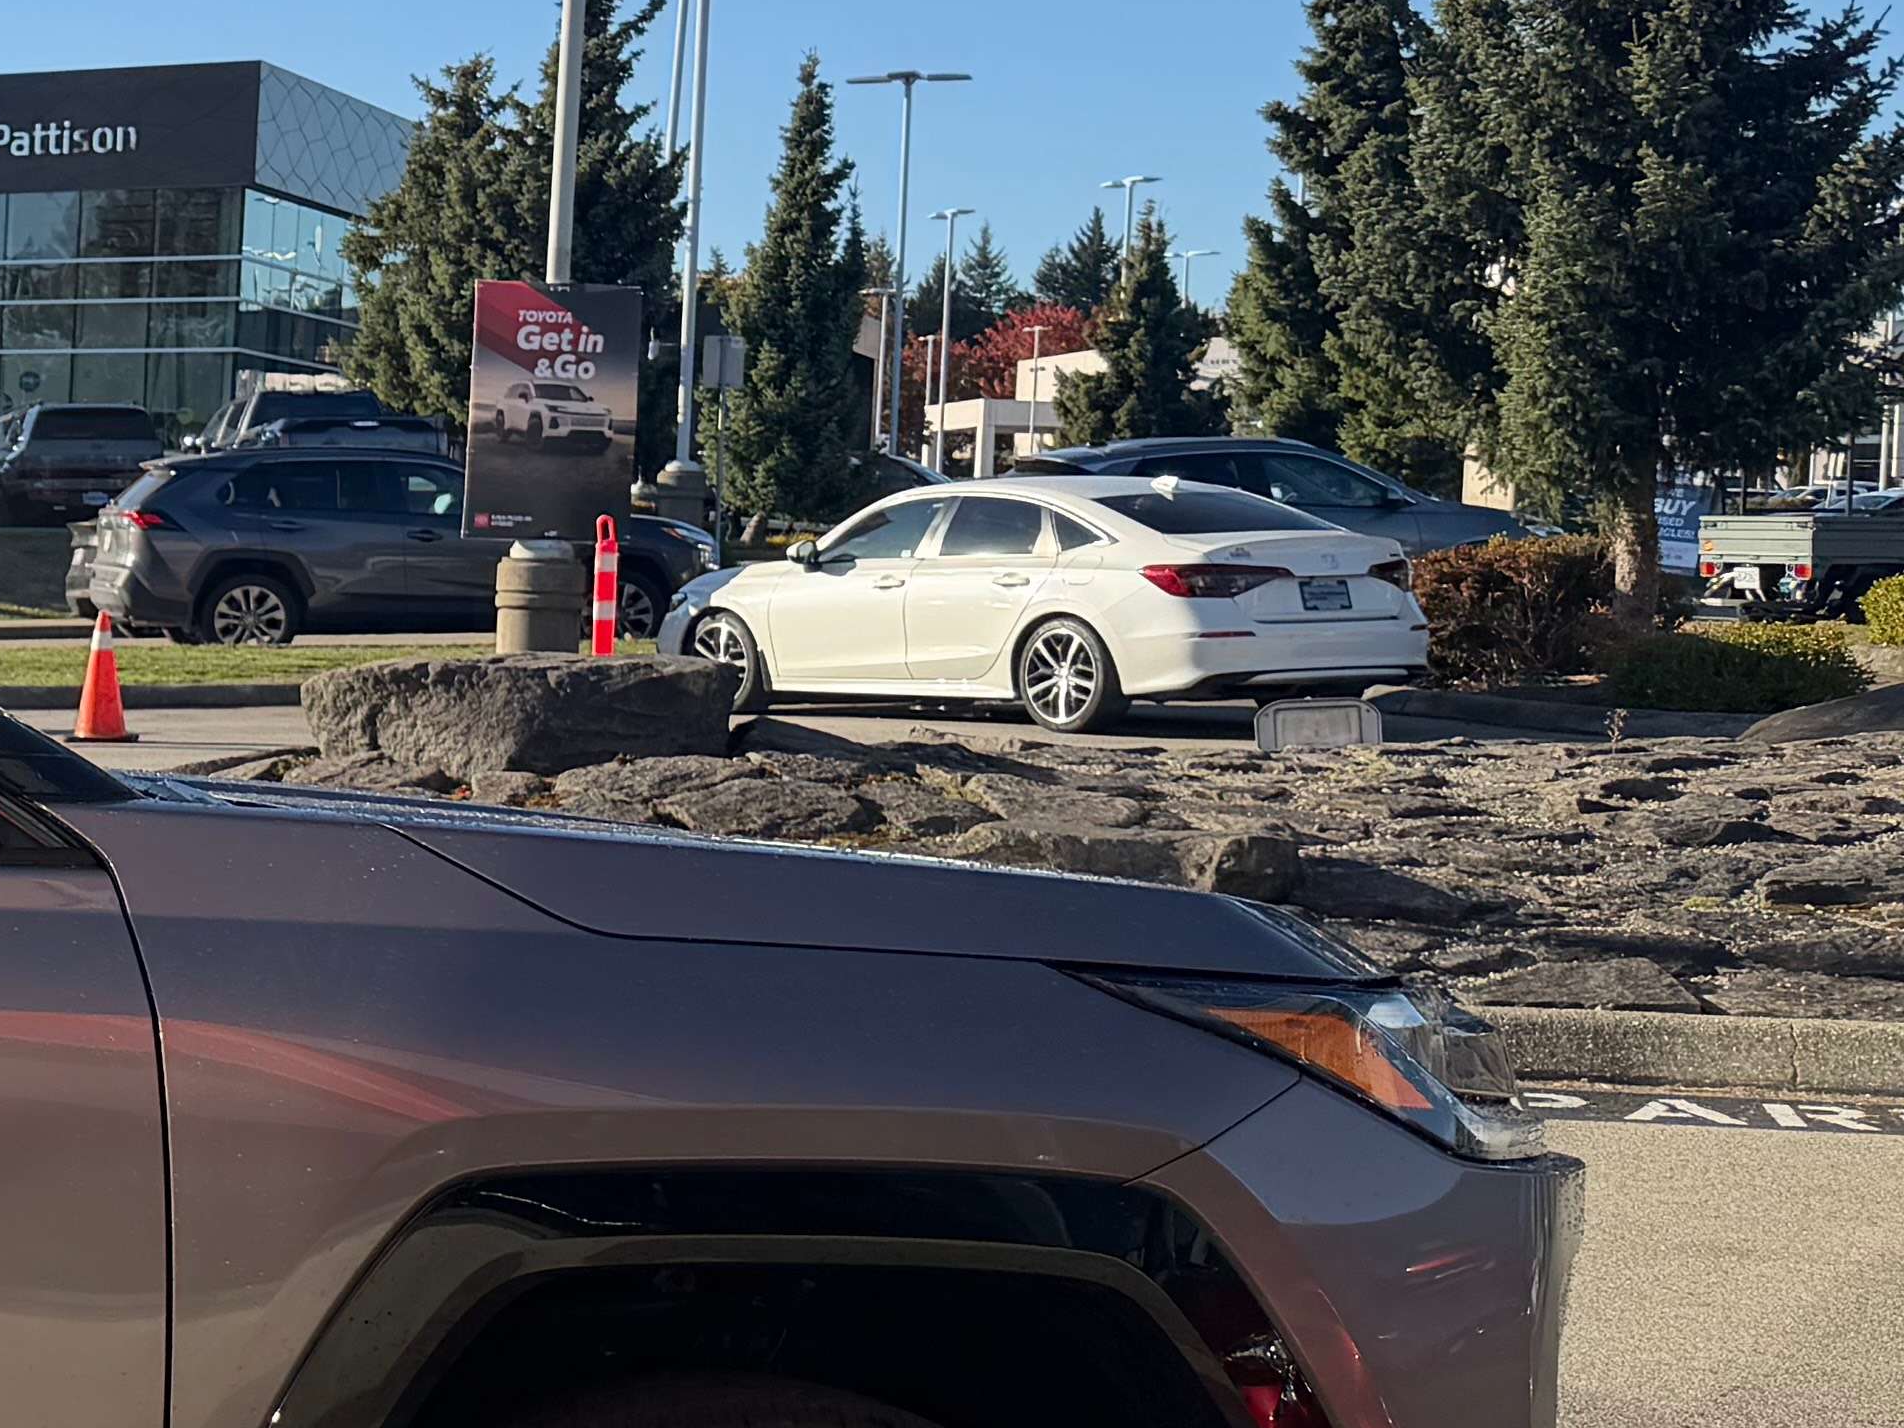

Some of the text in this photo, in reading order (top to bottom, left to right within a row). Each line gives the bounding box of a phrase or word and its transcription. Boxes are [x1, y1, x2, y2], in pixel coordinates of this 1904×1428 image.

[518, 309, 573, 324] TOYOTA
[516, 324, 604, 353] Get in
[1654, 497, 1696, 516] BUY
